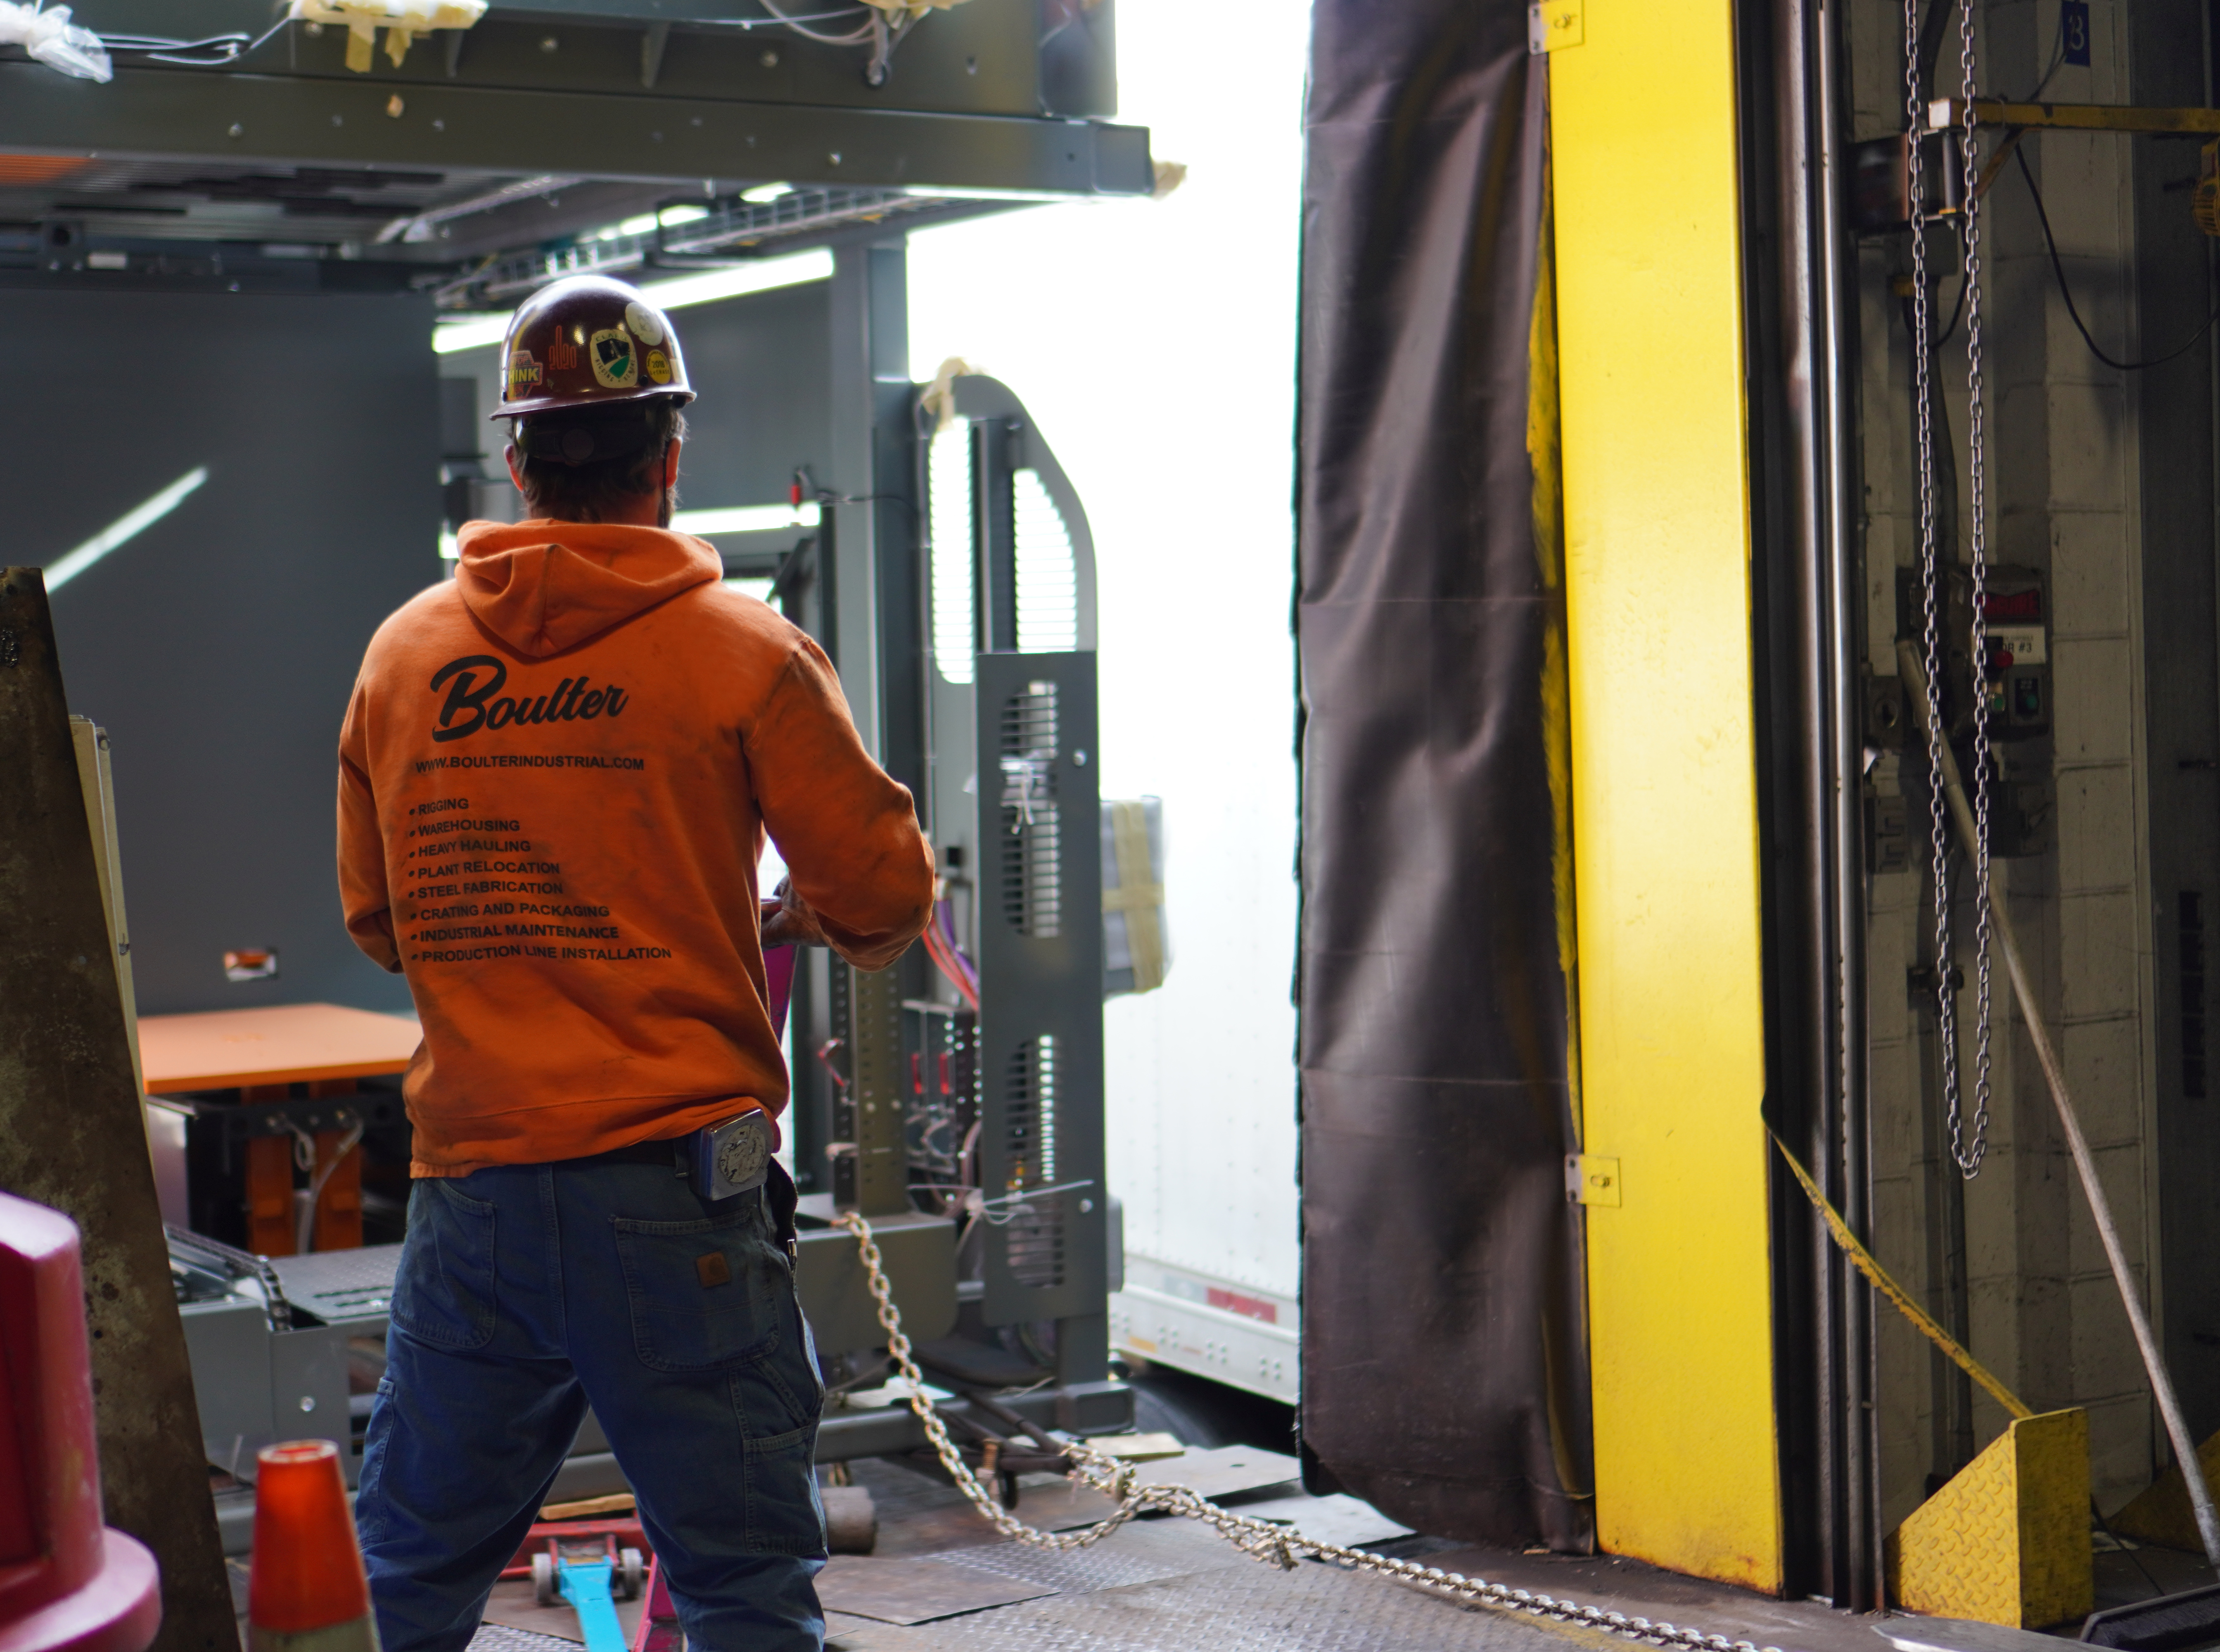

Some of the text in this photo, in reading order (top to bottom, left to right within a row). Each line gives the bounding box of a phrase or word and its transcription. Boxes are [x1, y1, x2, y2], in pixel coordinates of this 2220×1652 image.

[2068, 14, 2085, 50] 3
[508, 367, 539, 384] HINK
[429, 653, 629, 743] Boulter
[415, 755, 644, 773] WWW.BOULTERINDUSTRIAL.COM
[418, 798, 469, 816] RIGGING
[417, 819, 520, 837] WAREHOUSING
[418, 840, 531, 857] HEAVY HAULING
[418, 861, 560, 879] PLANT RELOCATION
[418, 881, 563, 899] STEEL FABRICATION
[420, 902, 610, 921] CRATING AND PACKAGING
[420, 924, 619, 942] INDUSTRIAL MAINTENANCE
[422, 945, 671, 962] PRODUCTION LINE INSTALLATION
